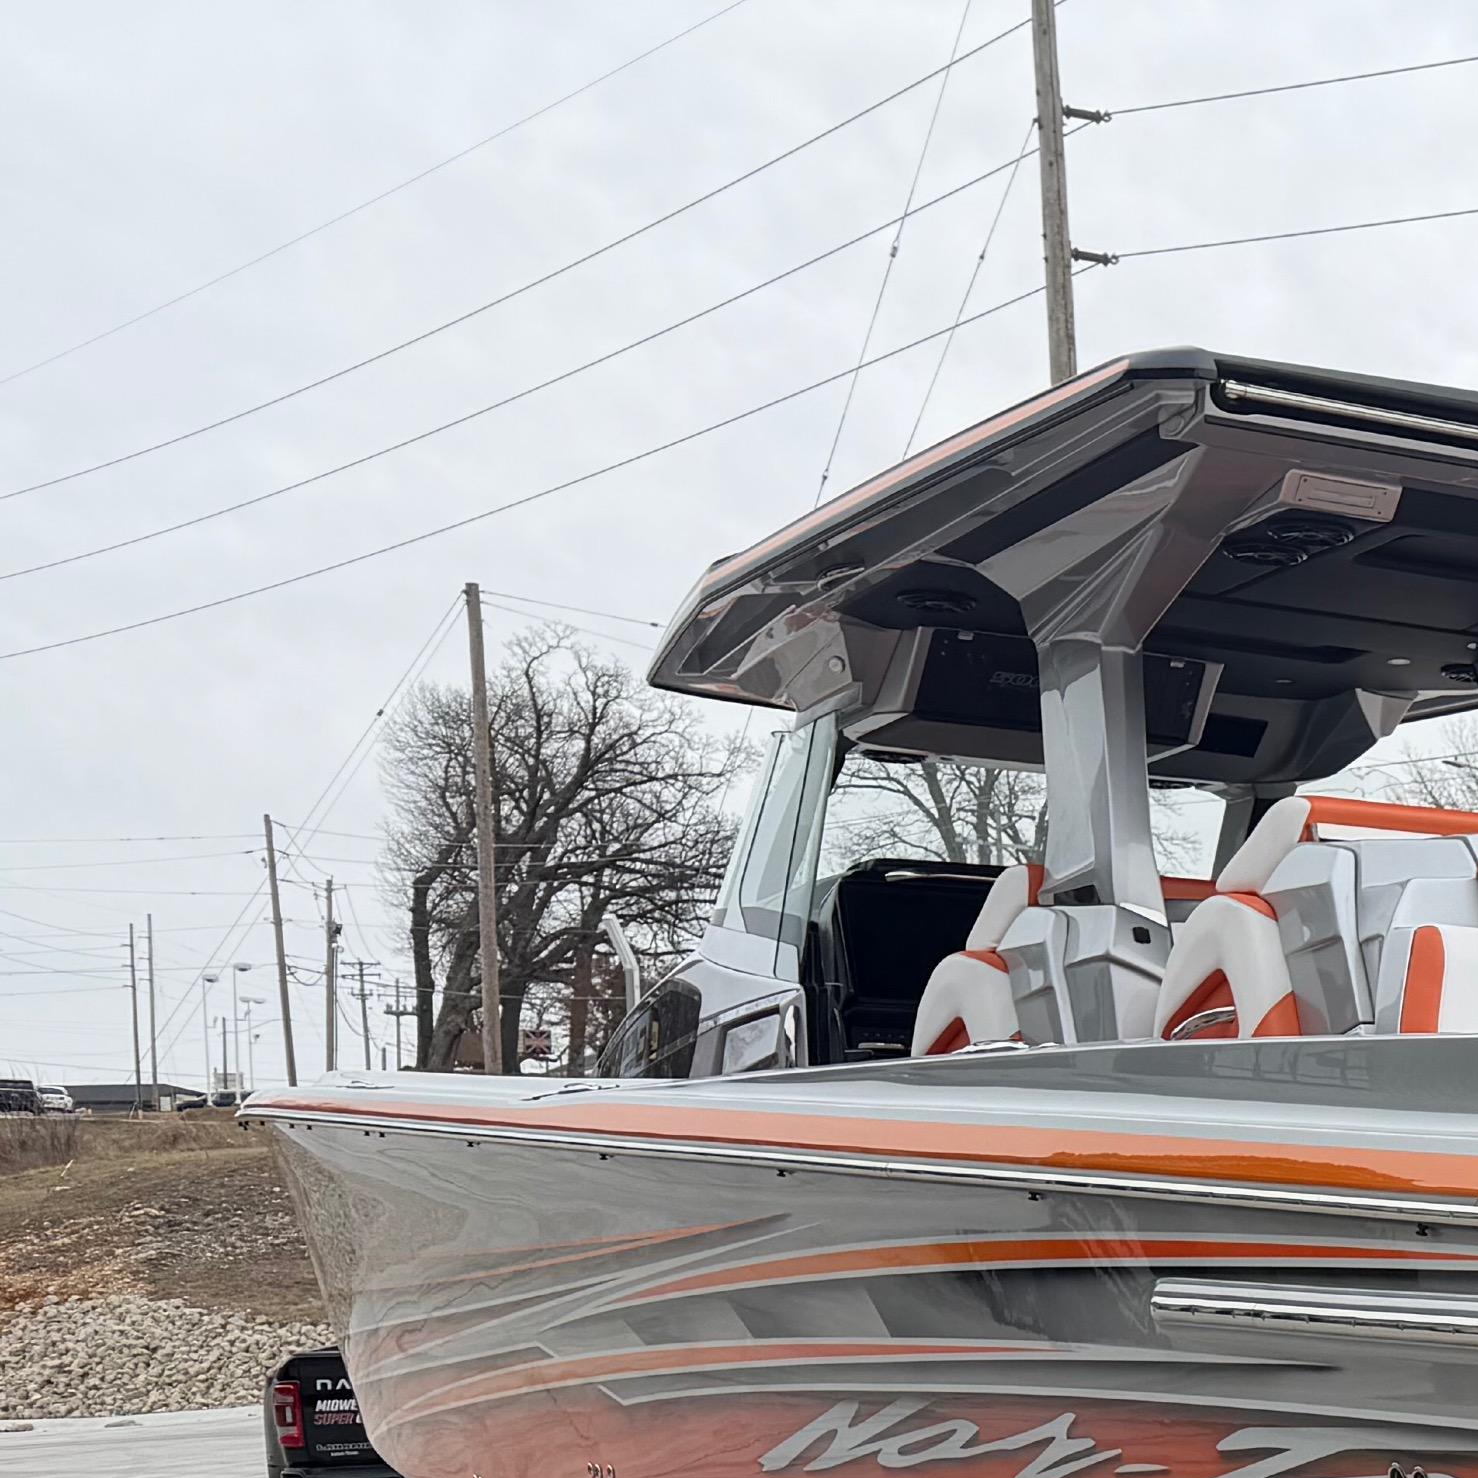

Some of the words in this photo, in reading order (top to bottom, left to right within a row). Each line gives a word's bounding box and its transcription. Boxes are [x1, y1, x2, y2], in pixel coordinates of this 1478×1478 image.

[315, 1378, 352, 1391] RA
[315, 1398, 359, 1412] MIDWE
[313, 1411, 354, 1425] SUPER
